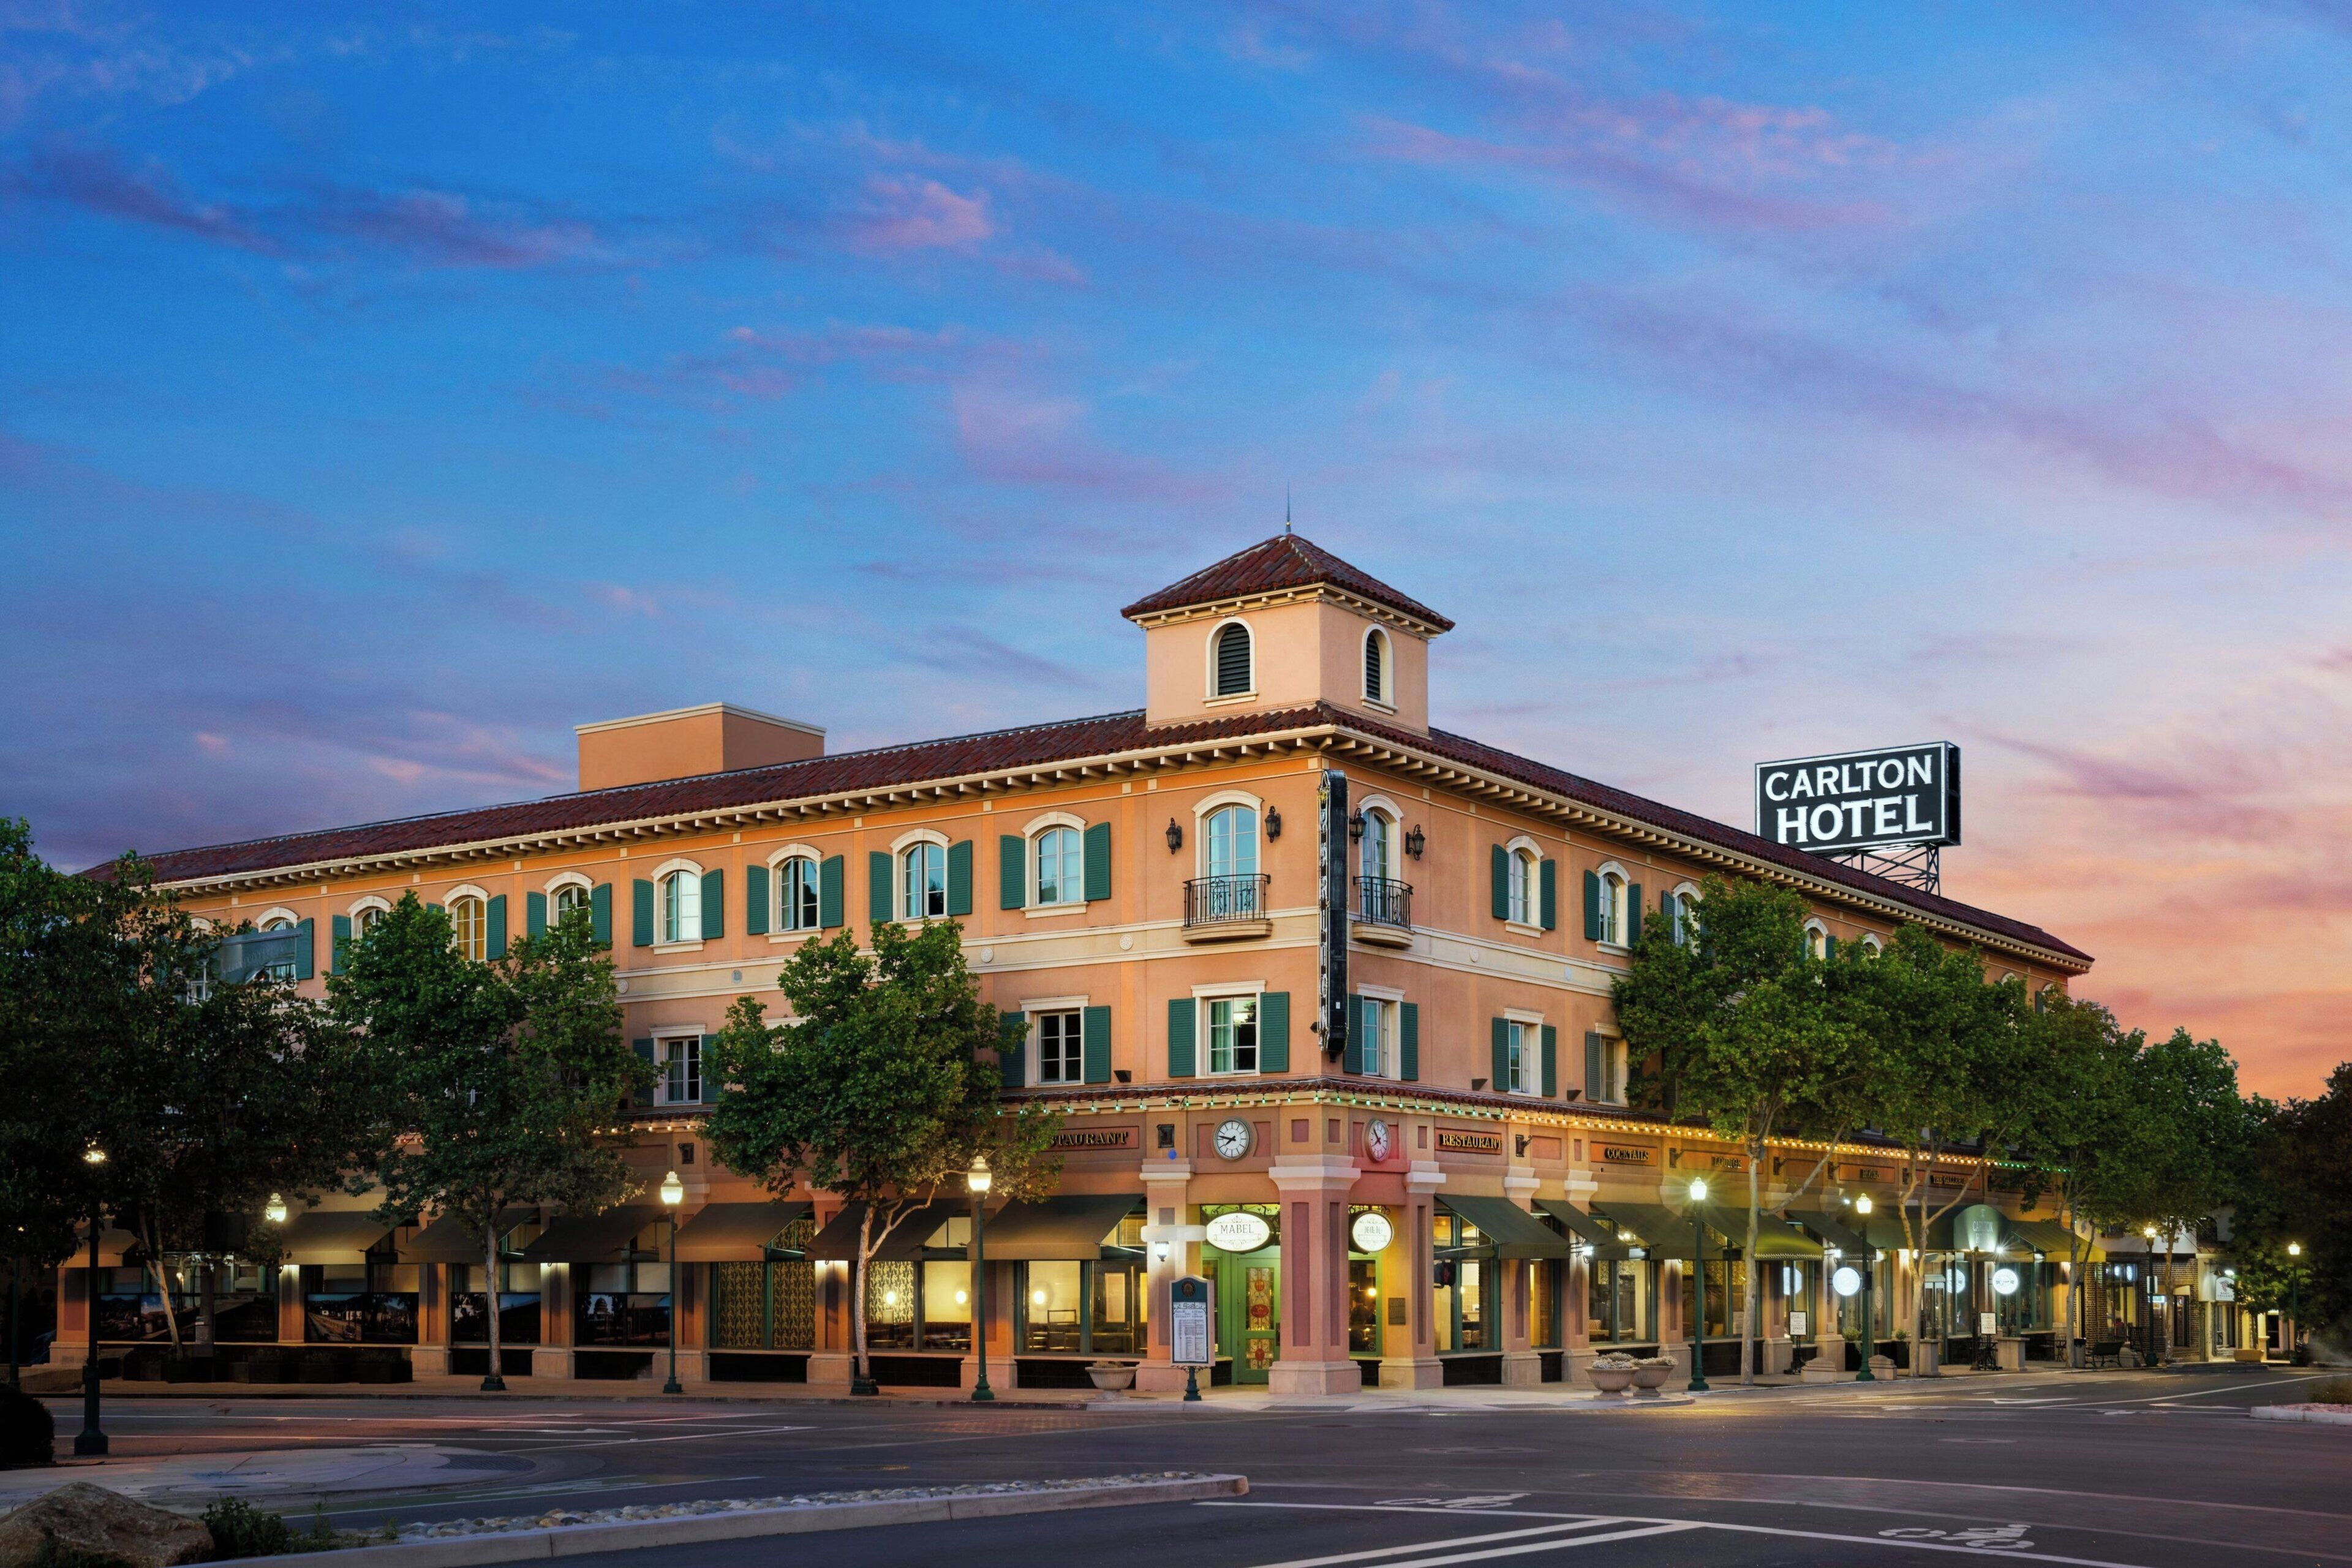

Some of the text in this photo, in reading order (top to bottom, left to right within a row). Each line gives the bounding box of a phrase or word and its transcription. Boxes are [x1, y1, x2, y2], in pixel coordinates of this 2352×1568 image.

[1765, 754, 1933, 801] CARLTON
[1776, 794, 1932, 844] HOTEL
[1442, 1133, 1502, 1150] RESTAURANT
[1607, 1147, 1649, 1161] COCKTAILS
[1714, 1156, 1742, 1169] LOUNGE
[1221, 1224, 1254, 1234] MABEL
